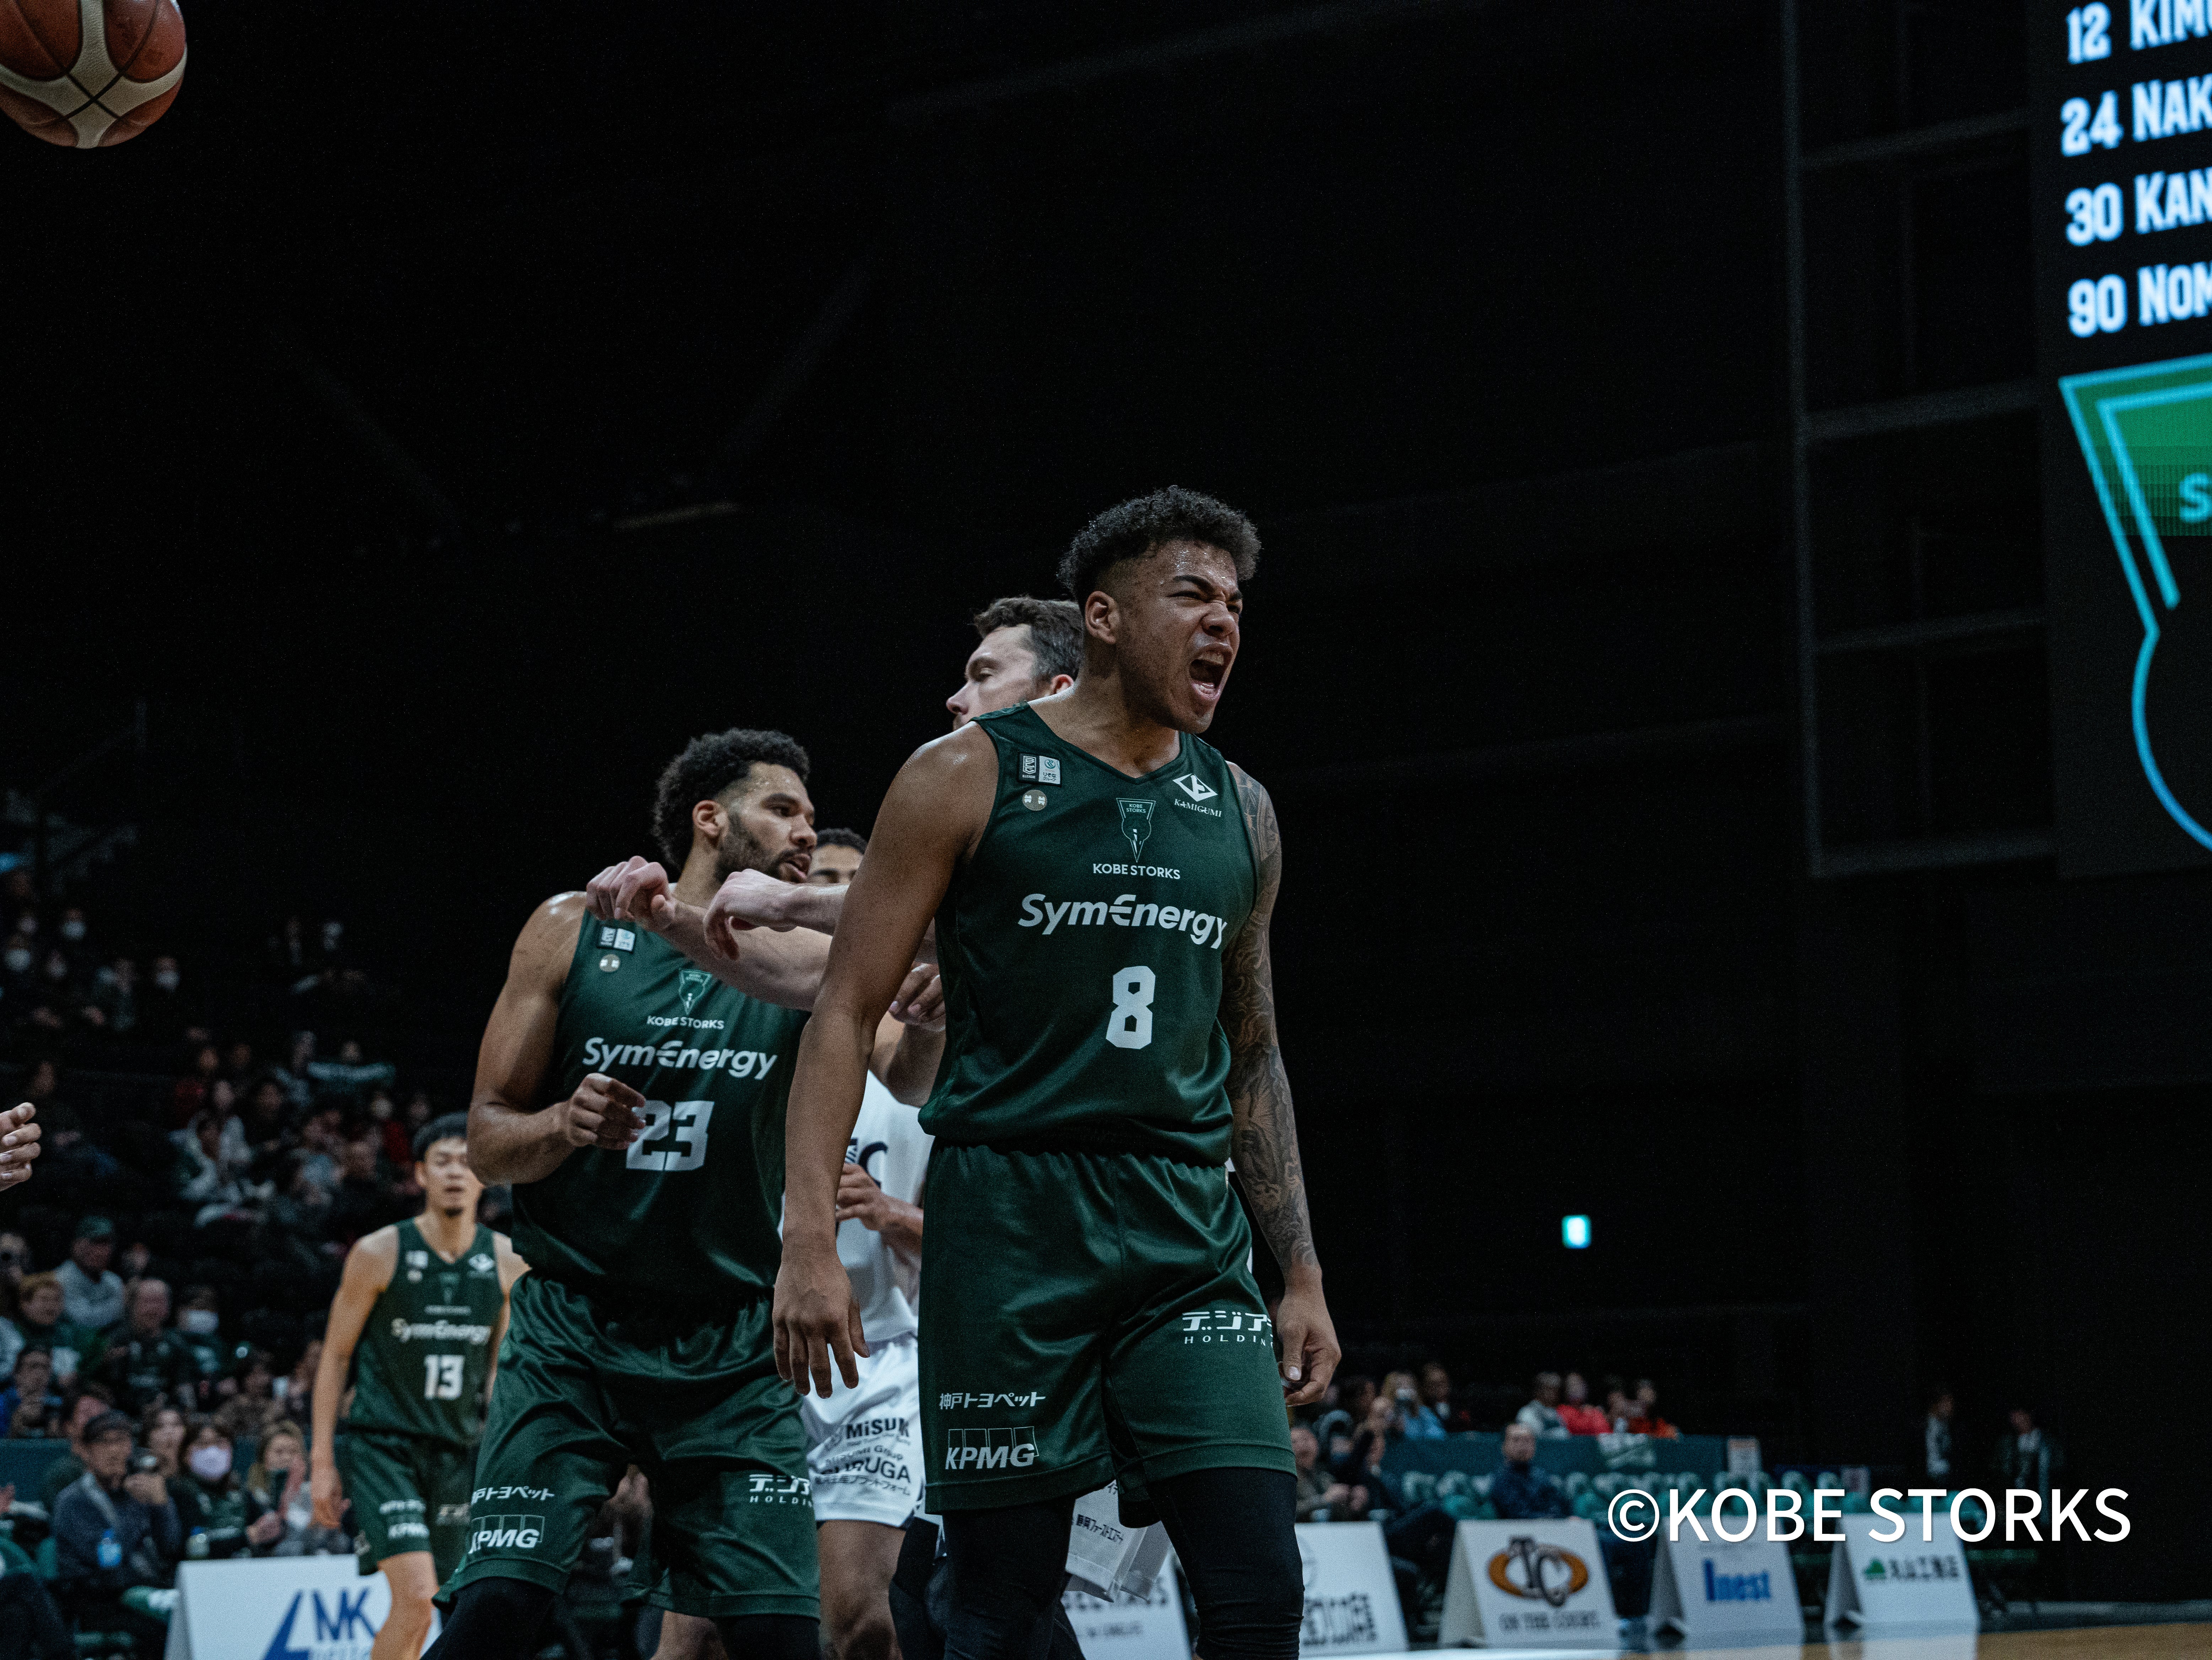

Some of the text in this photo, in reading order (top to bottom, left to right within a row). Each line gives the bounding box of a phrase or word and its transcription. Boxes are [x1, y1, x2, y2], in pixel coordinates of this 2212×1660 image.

[2066, 1, 2111, 64] 12
[2061, 90, 2125, 157] 24
[2065, 182, 2124, 246] 30
[2068, 274, 2127, 338] 90
[1175, 798, 1222, 817] KAMIGUMI
[1093, 863, 1181, 879] KOBE STORKS
[1018, 893, 1228, 949] SymEnergy
[1106, 966, 1155, 1049] 8
[582, 1037, 778, 1080] SymEnergy
[626, 1100, 715, 1171] 23
[1182, 1310, 1272, 1331] デジア
[1185, 1334, 1273, 1348] HOLDIN
[423, 1354, 465, 1400] 13
[939, 1392, 1046, 1410] 神戸トヨペット
[945, 1443, 1035, 1470] KPMG
